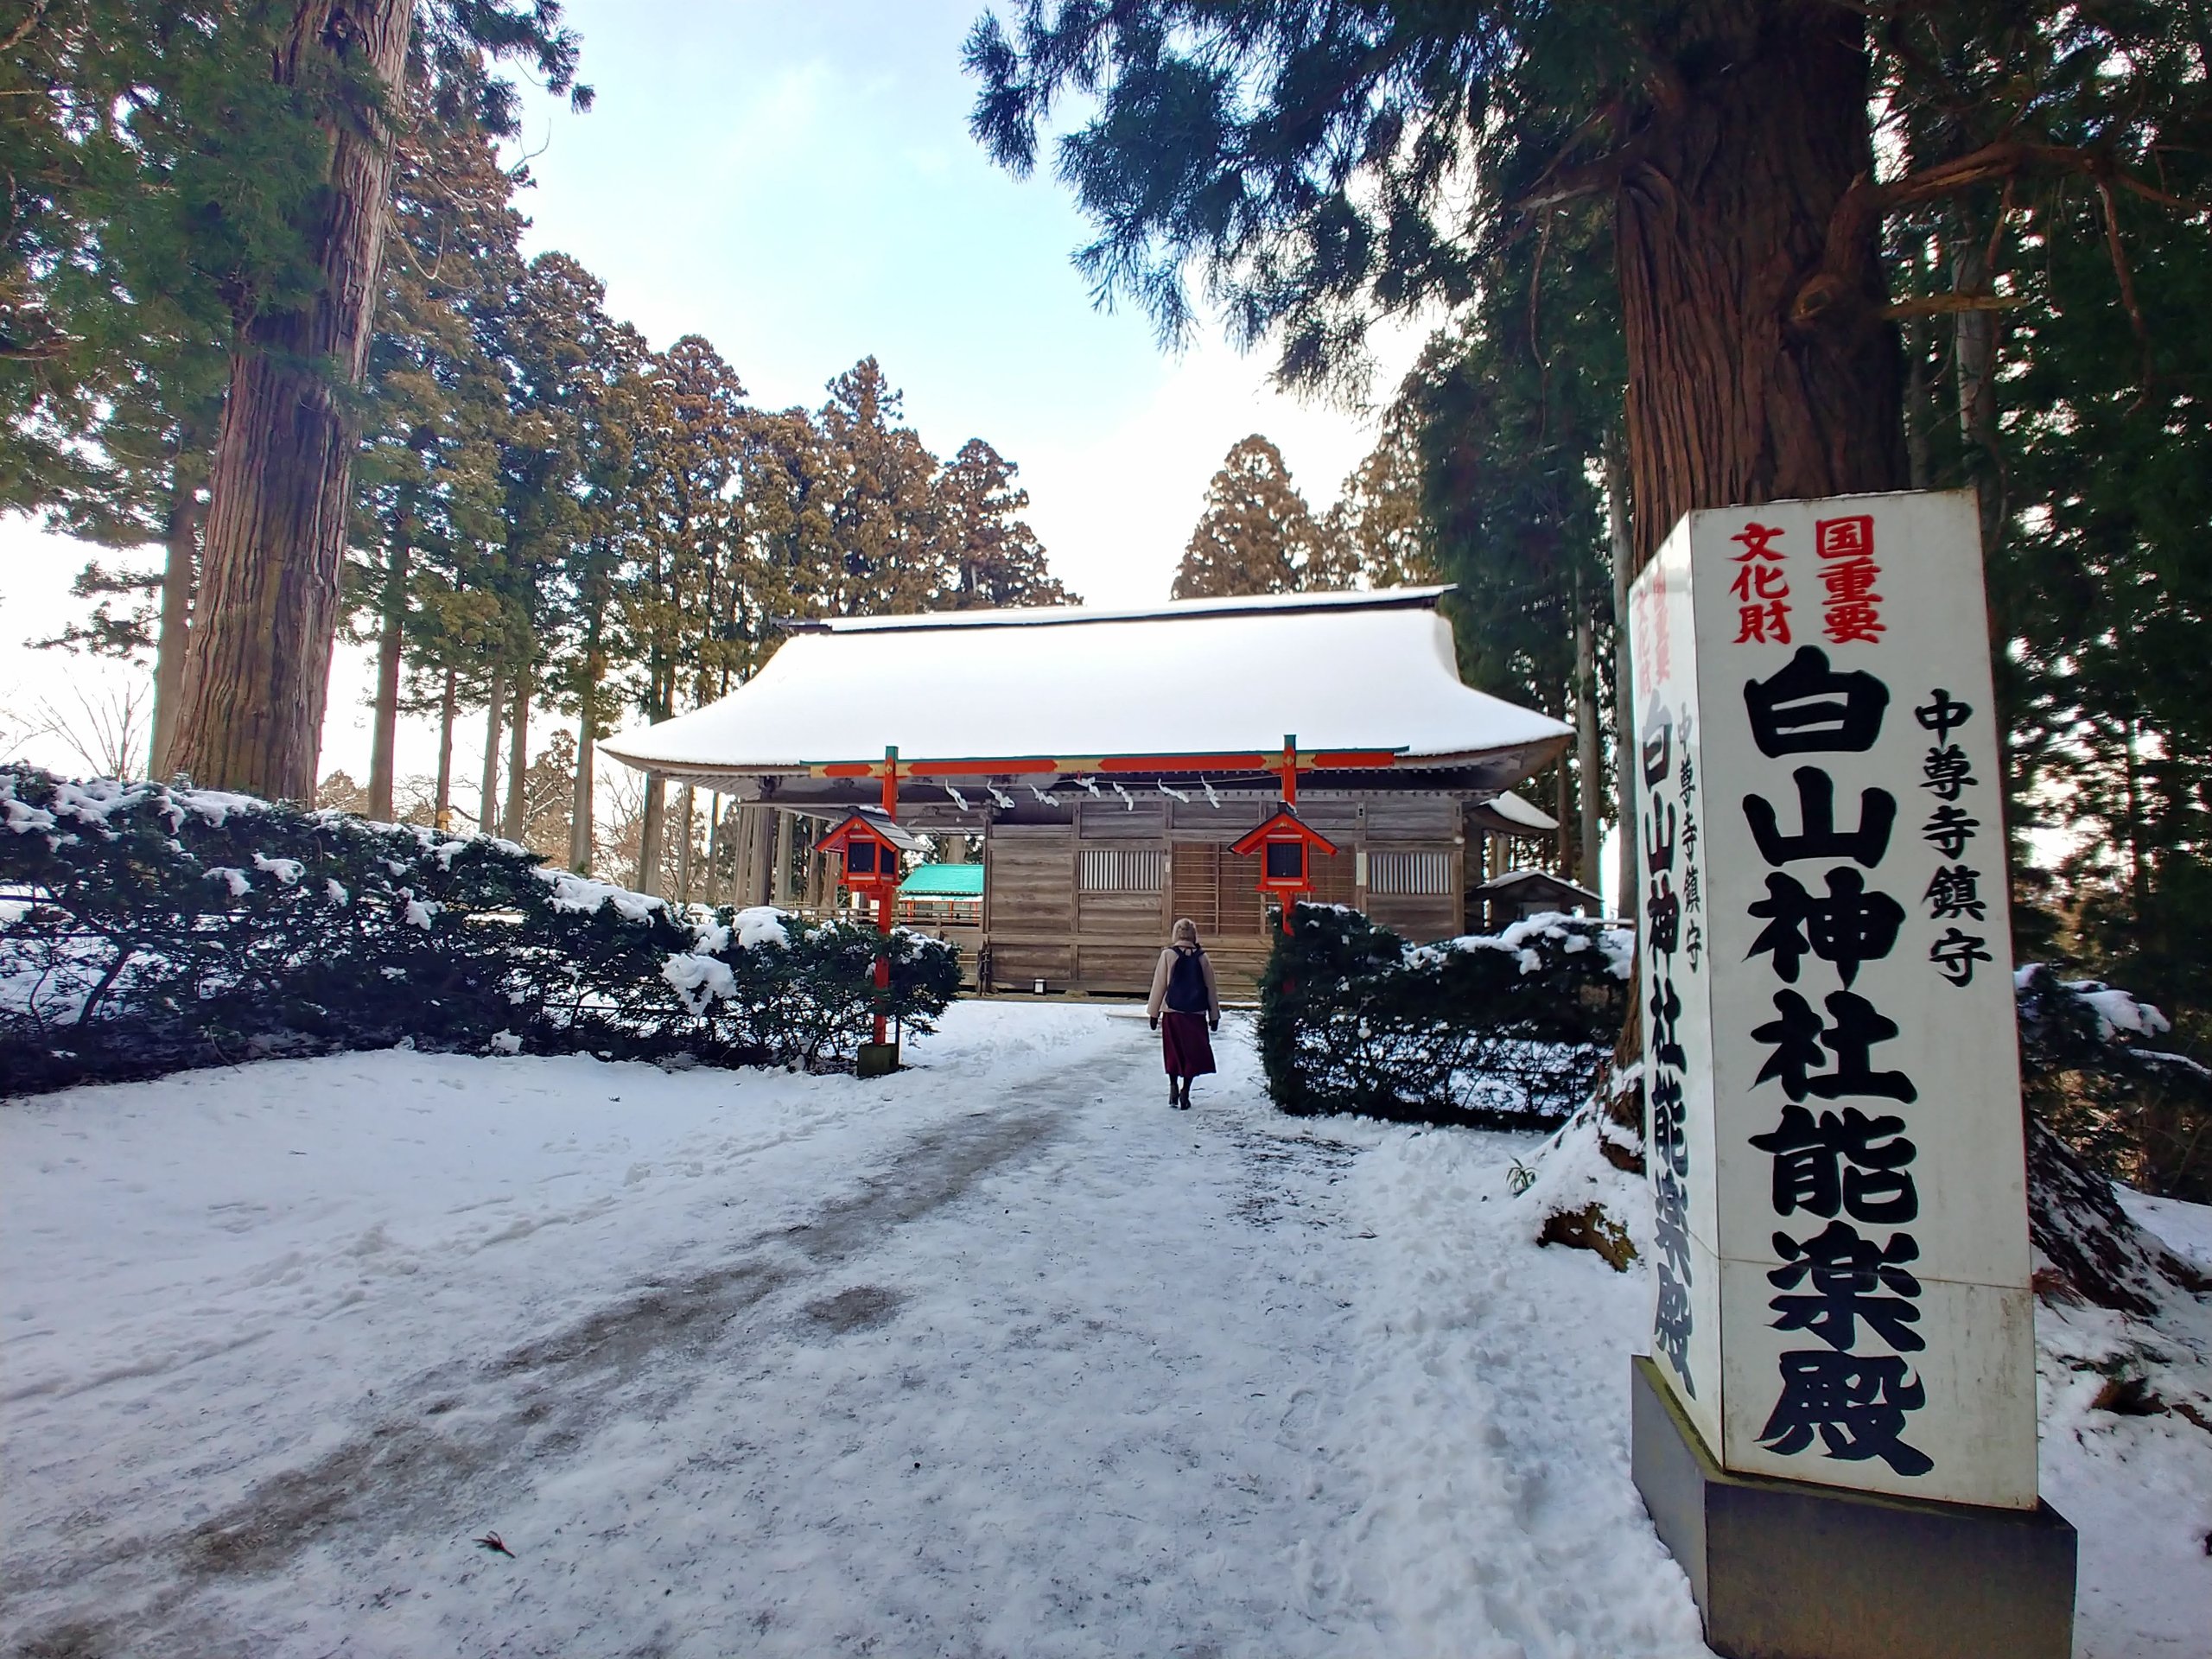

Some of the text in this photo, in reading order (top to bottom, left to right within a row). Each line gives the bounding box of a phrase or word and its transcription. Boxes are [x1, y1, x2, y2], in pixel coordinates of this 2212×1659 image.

[1731, 523, 1792, 645] 文化財
[1815, 516, 1886, 645] 国重要
[1677, 702, 1702, 974] 中尊寺鎮守
[1914, 689, 1993, 988] 中尊寺鎮守
[1642, 688, 1697, 1401] 白山神社能楽殿
[1742, 645, 1935, 1477] 白山神社能楽殿
